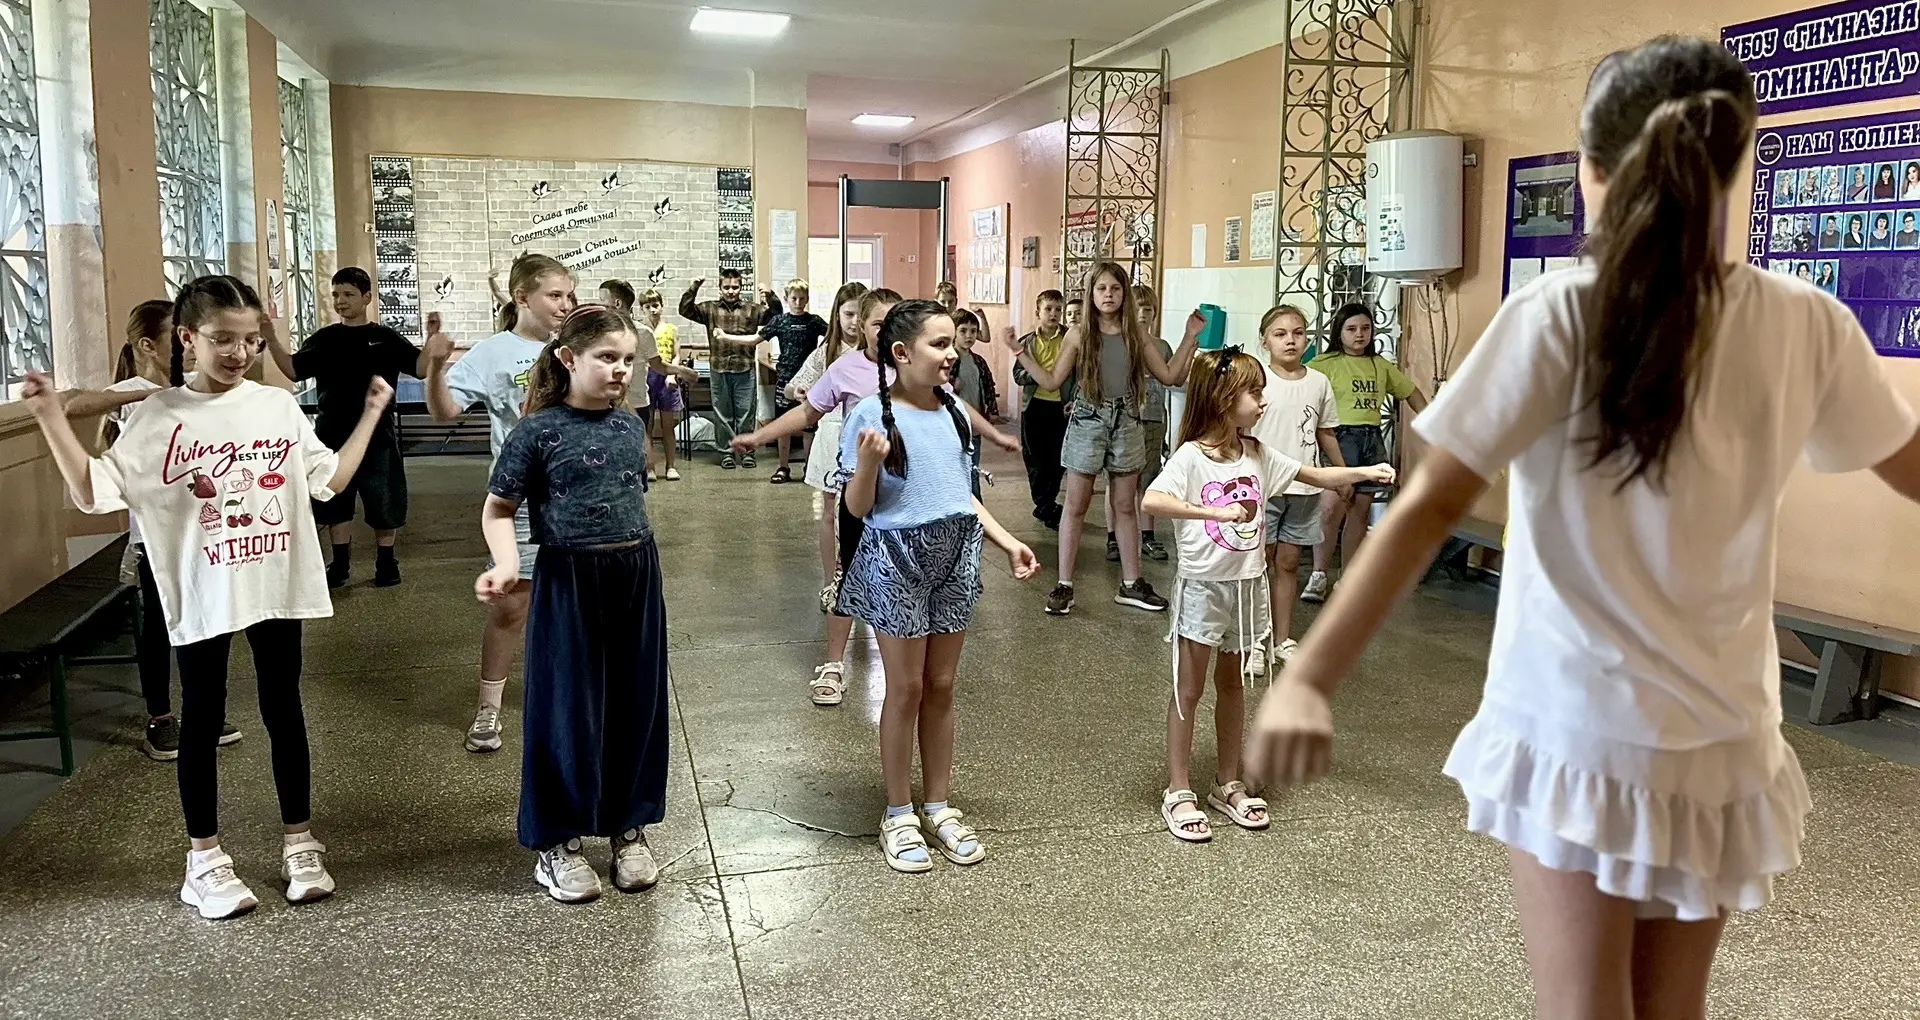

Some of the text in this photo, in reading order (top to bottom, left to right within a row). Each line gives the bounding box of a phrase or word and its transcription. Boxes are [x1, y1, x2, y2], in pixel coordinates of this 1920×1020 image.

[1725, 1, 1919, 61] МБОУ «ГИМНАЗИЯ
[1750, 48, 1919, 103] ОМИНАНТА»
[1786, 131, 1834, 157] НАШ
[532, 201, 588, 225] Слава тебе
[511, 209, 618, 245] Советская Отчизна!
[555, 236, 618, 261] твои Сыны
[604, 240, 642, 259] дошли!
[163, 423, 298, 485] Living my
[231, 450, 283, 463] BEST LIFE
[263, 478, 279, 487] SALE
[203, 531, 291, 566] WITHOUT
